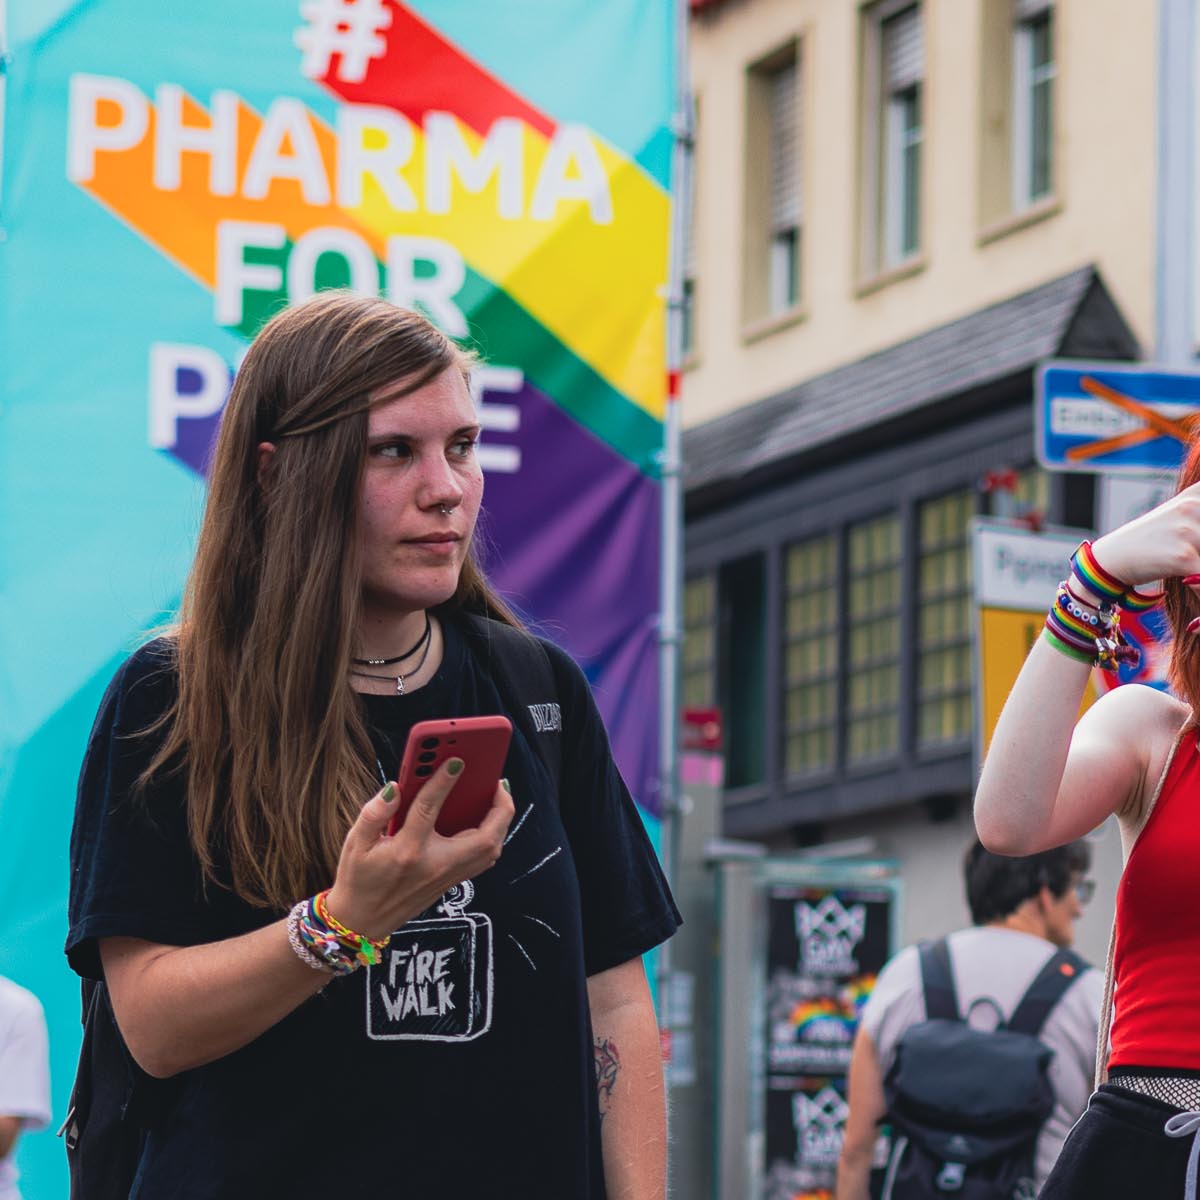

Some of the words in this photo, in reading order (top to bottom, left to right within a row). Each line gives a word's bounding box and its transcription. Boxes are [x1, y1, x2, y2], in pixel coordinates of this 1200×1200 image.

[66, 72, 614, 225] PHARMA
[214, 219, 470, 340] FOR
[380, 978, 456, 1022] WALK
